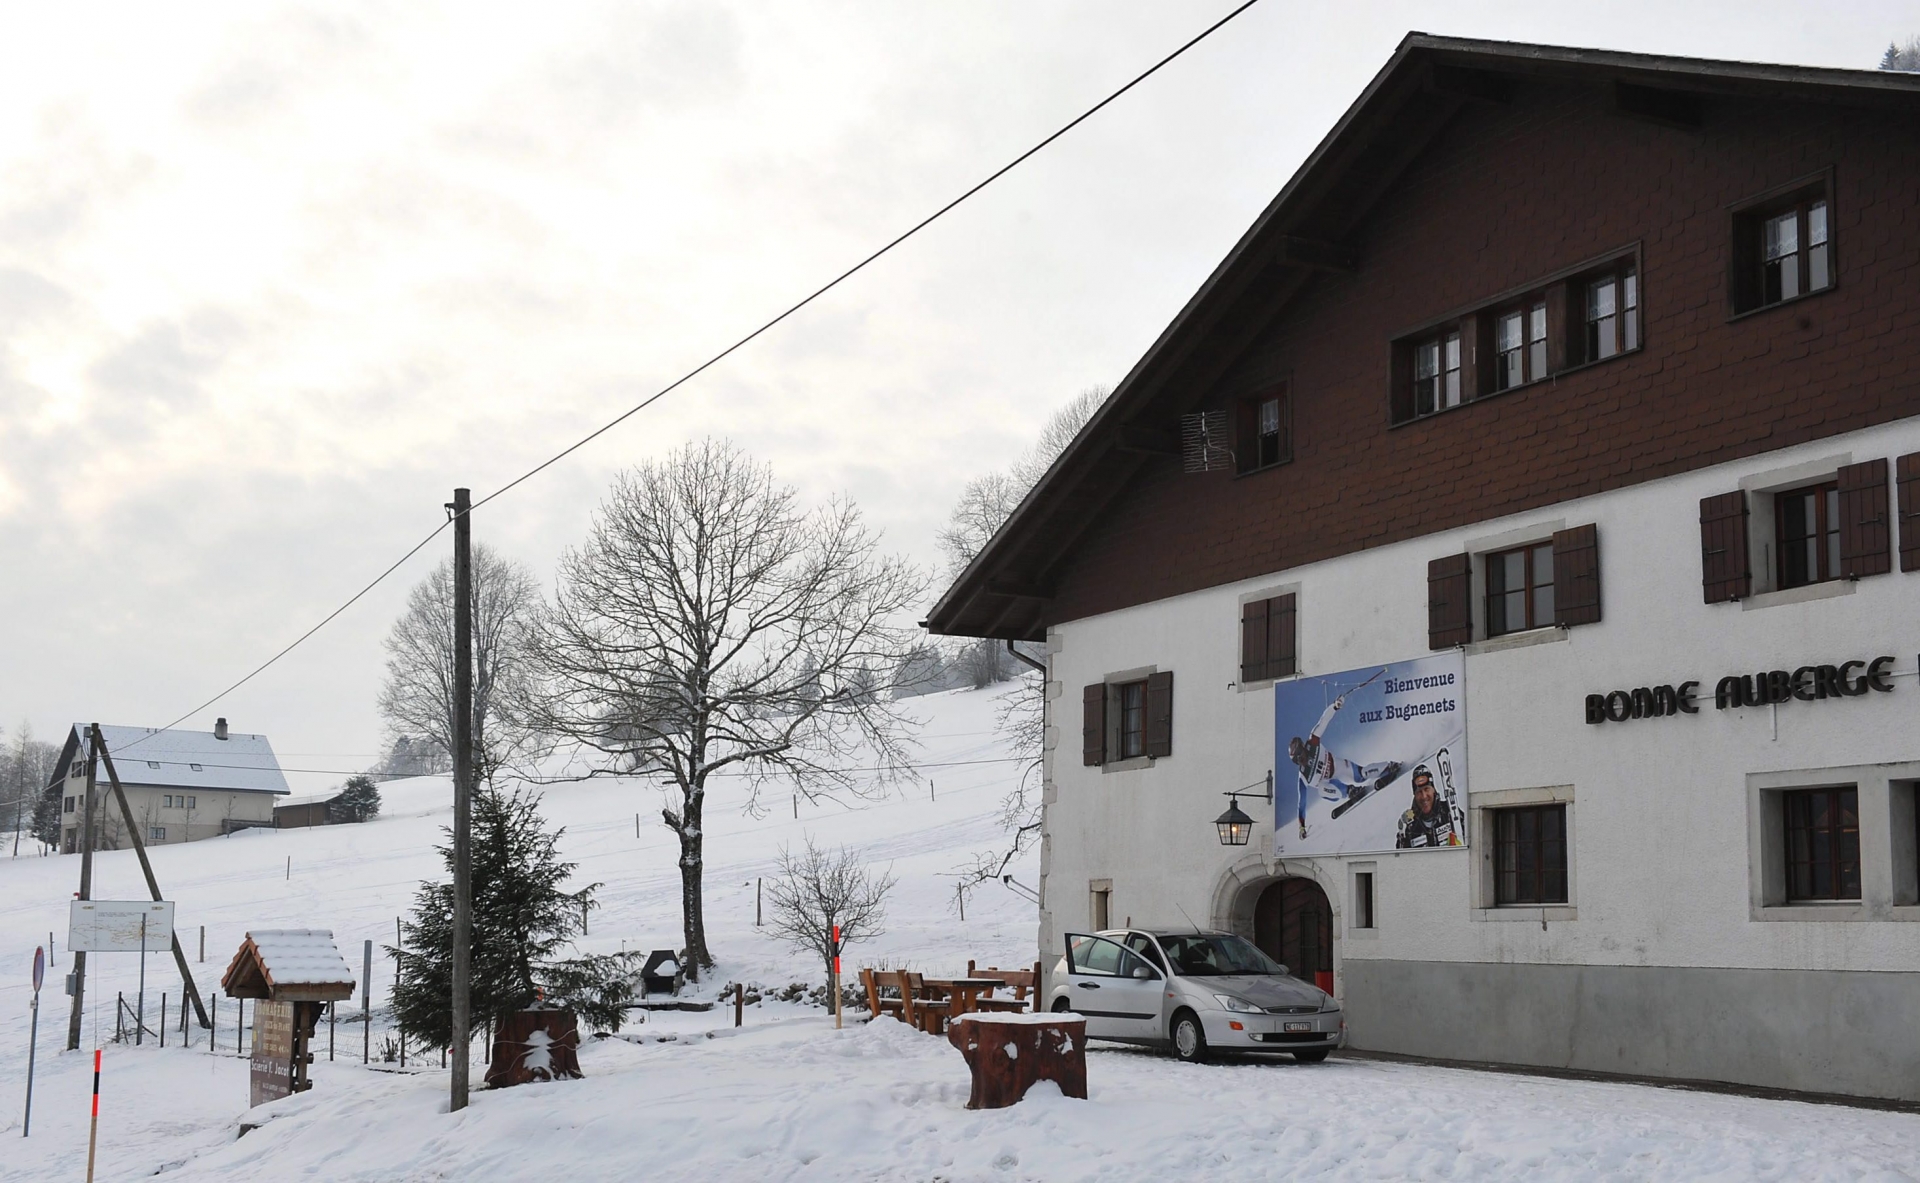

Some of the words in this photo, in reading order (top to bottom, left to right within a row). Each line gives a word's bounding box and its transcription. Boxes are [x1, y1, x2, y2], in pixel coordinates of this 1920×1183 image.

[1384, 672, 1455, 695] Bienvenue
[1585, 680, 1700, 725] BONNE
[1715, 655, 1896, 710] AUBERGE
[1359, 710, 1383, 724] aux
[1385, 697, 1456, 721] Bugnenets
[251, 1058, 268, 1073] Scierie
